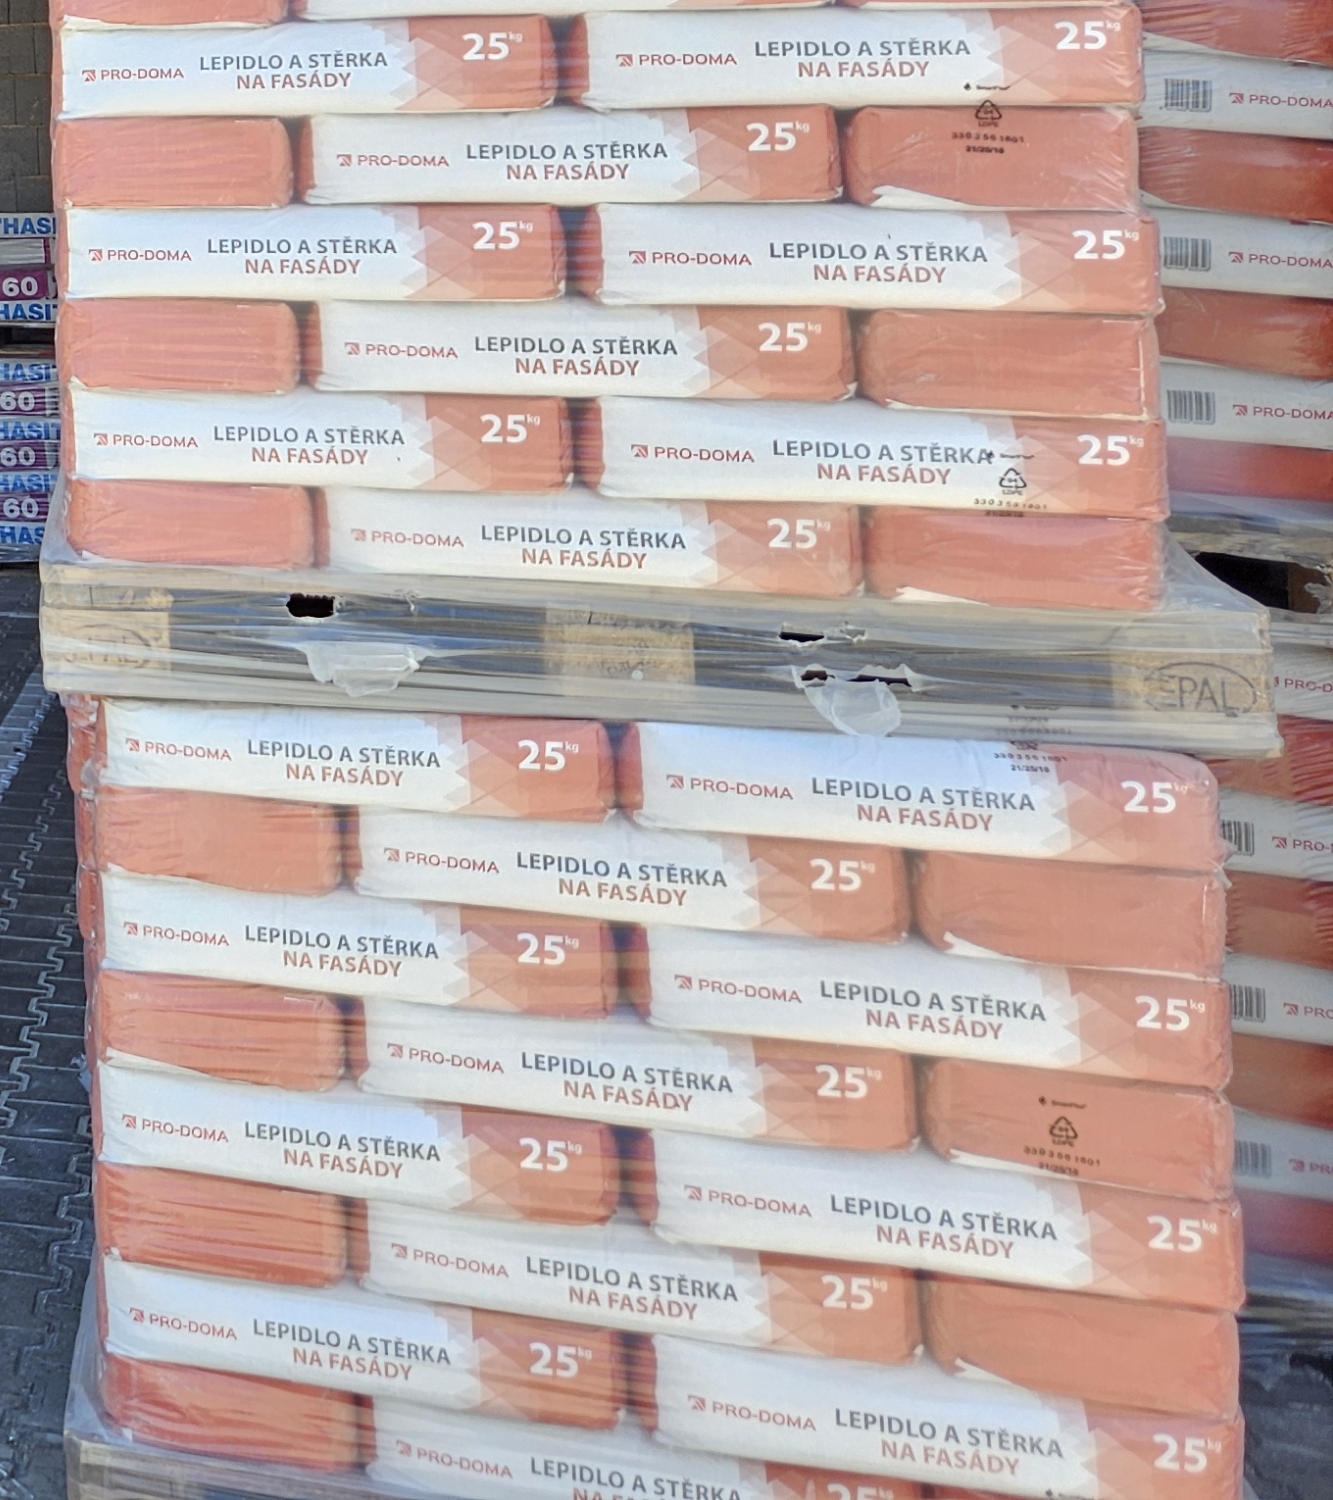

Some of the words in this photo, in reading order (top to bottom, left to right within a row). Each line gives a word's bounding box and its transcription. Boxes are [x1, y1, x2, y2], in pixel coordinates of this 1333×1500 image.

[639, 54, 737, 65] PRO-DOMA
[755, 41, 850, 56] LEPIDLO
[858, 41, 872, 56] A
[880, 38, 970, 55] STĚRKA
[799, 62, 830, 77] NA
[838, 58, 929, 77] FASÁDY
[3, 218, 56, 234] HASI
[145, 742, 231, 761] PRO-DOMA
[248, 740, 332, 760] LEPIDLO
[340, 747, 353, 762] A
[359, 746, 440, 769] STĚRKA
[287, 765, 314, 781] NA
[322, 766, 403, 786] FASÁDY
[699, 979, 802, 1003] PRO-DOMA
[821, 981, 920, 1007] LEPIDLO
[929, 993, 944, 1009] A
[952, 995, 1046, 1021] STĚRKA
[866, 1009, 899, 1029] NA
[908, 1012, 1004, 1039] FASÁDY
